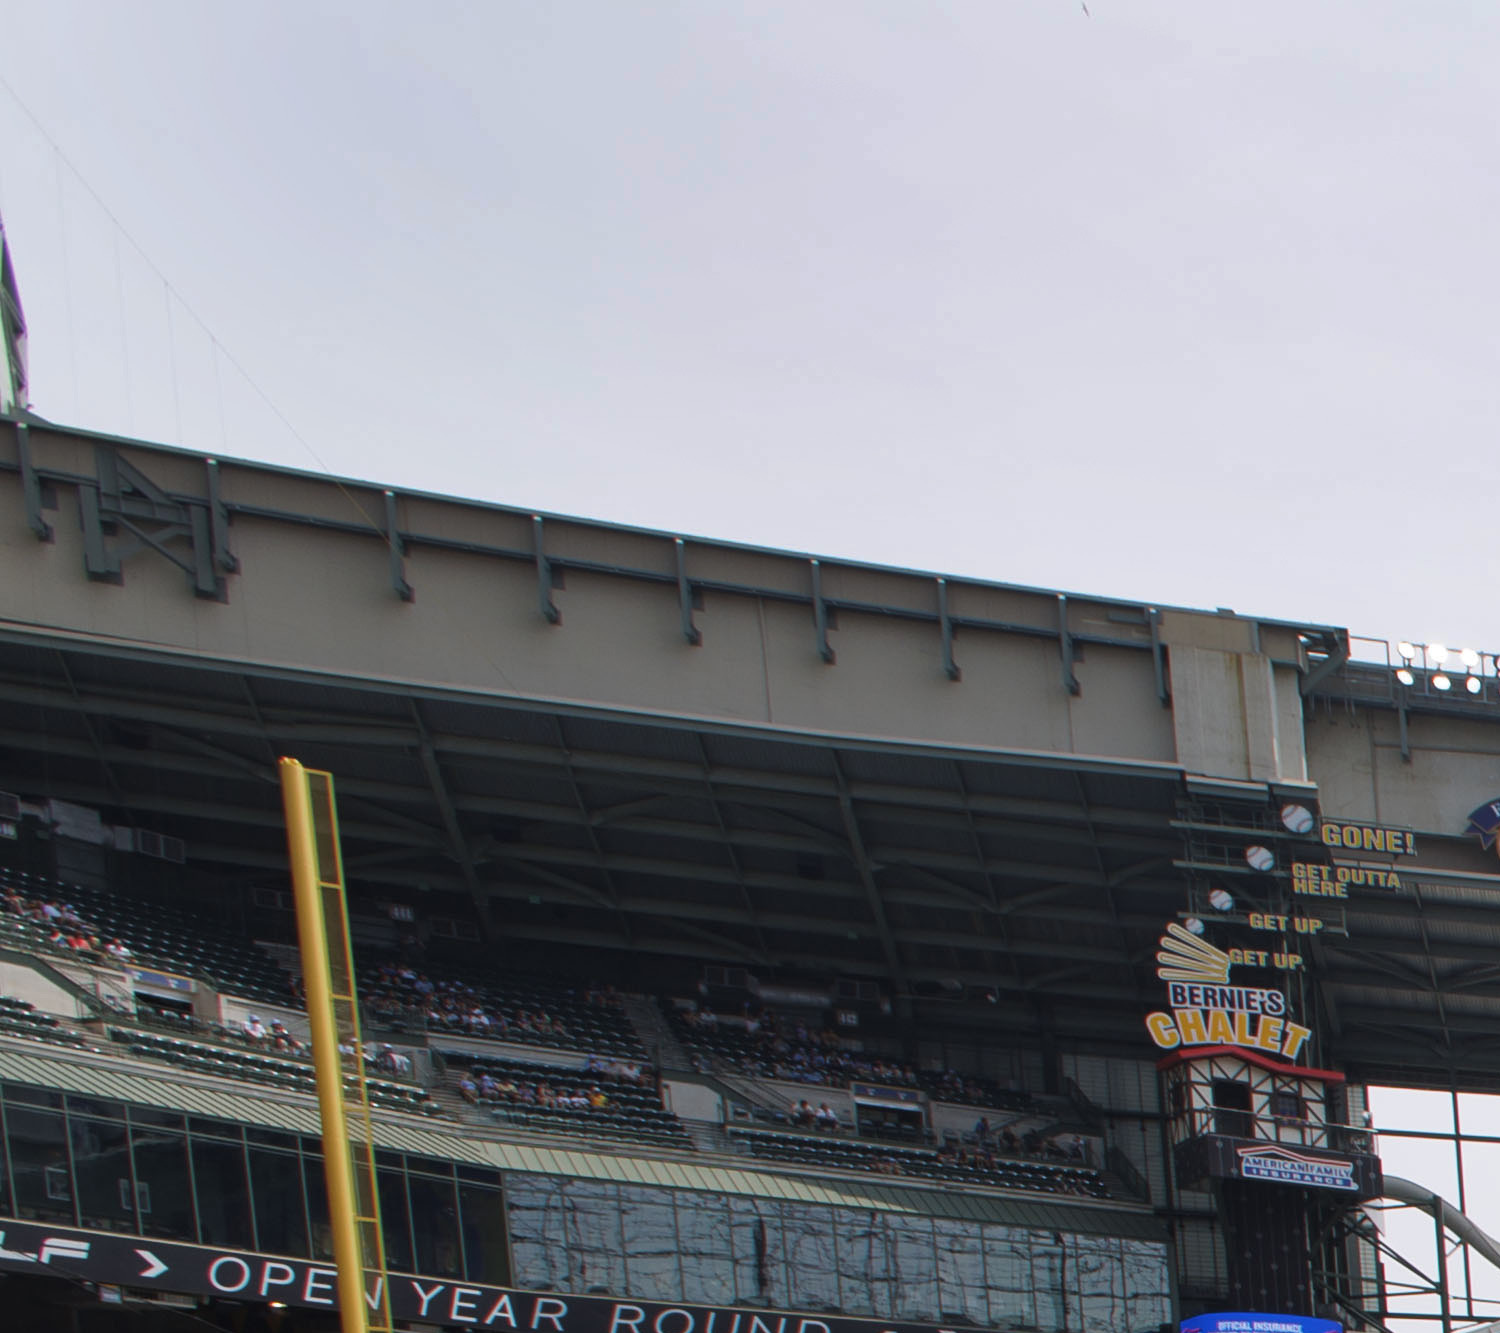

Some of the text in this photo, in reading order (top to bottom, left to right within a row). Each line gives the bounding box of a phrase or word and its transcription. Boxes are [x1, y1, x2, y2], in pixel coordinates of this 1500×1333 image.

[1321, 823, 1416, 856] GONE!
[1292, 862, 1402, 889] GET OUTTA
[1293, 878, 1349, 899] HERE
[1249, 912, 1323, 935] GET UP
[1229, 948, 1303, 970] GET UP
[1168, 981, 1286, 1015] BERNIE'S
[1145, 1008, 1312, 1060] CHALET
[410, 1281, 569, 1331] YEAR
